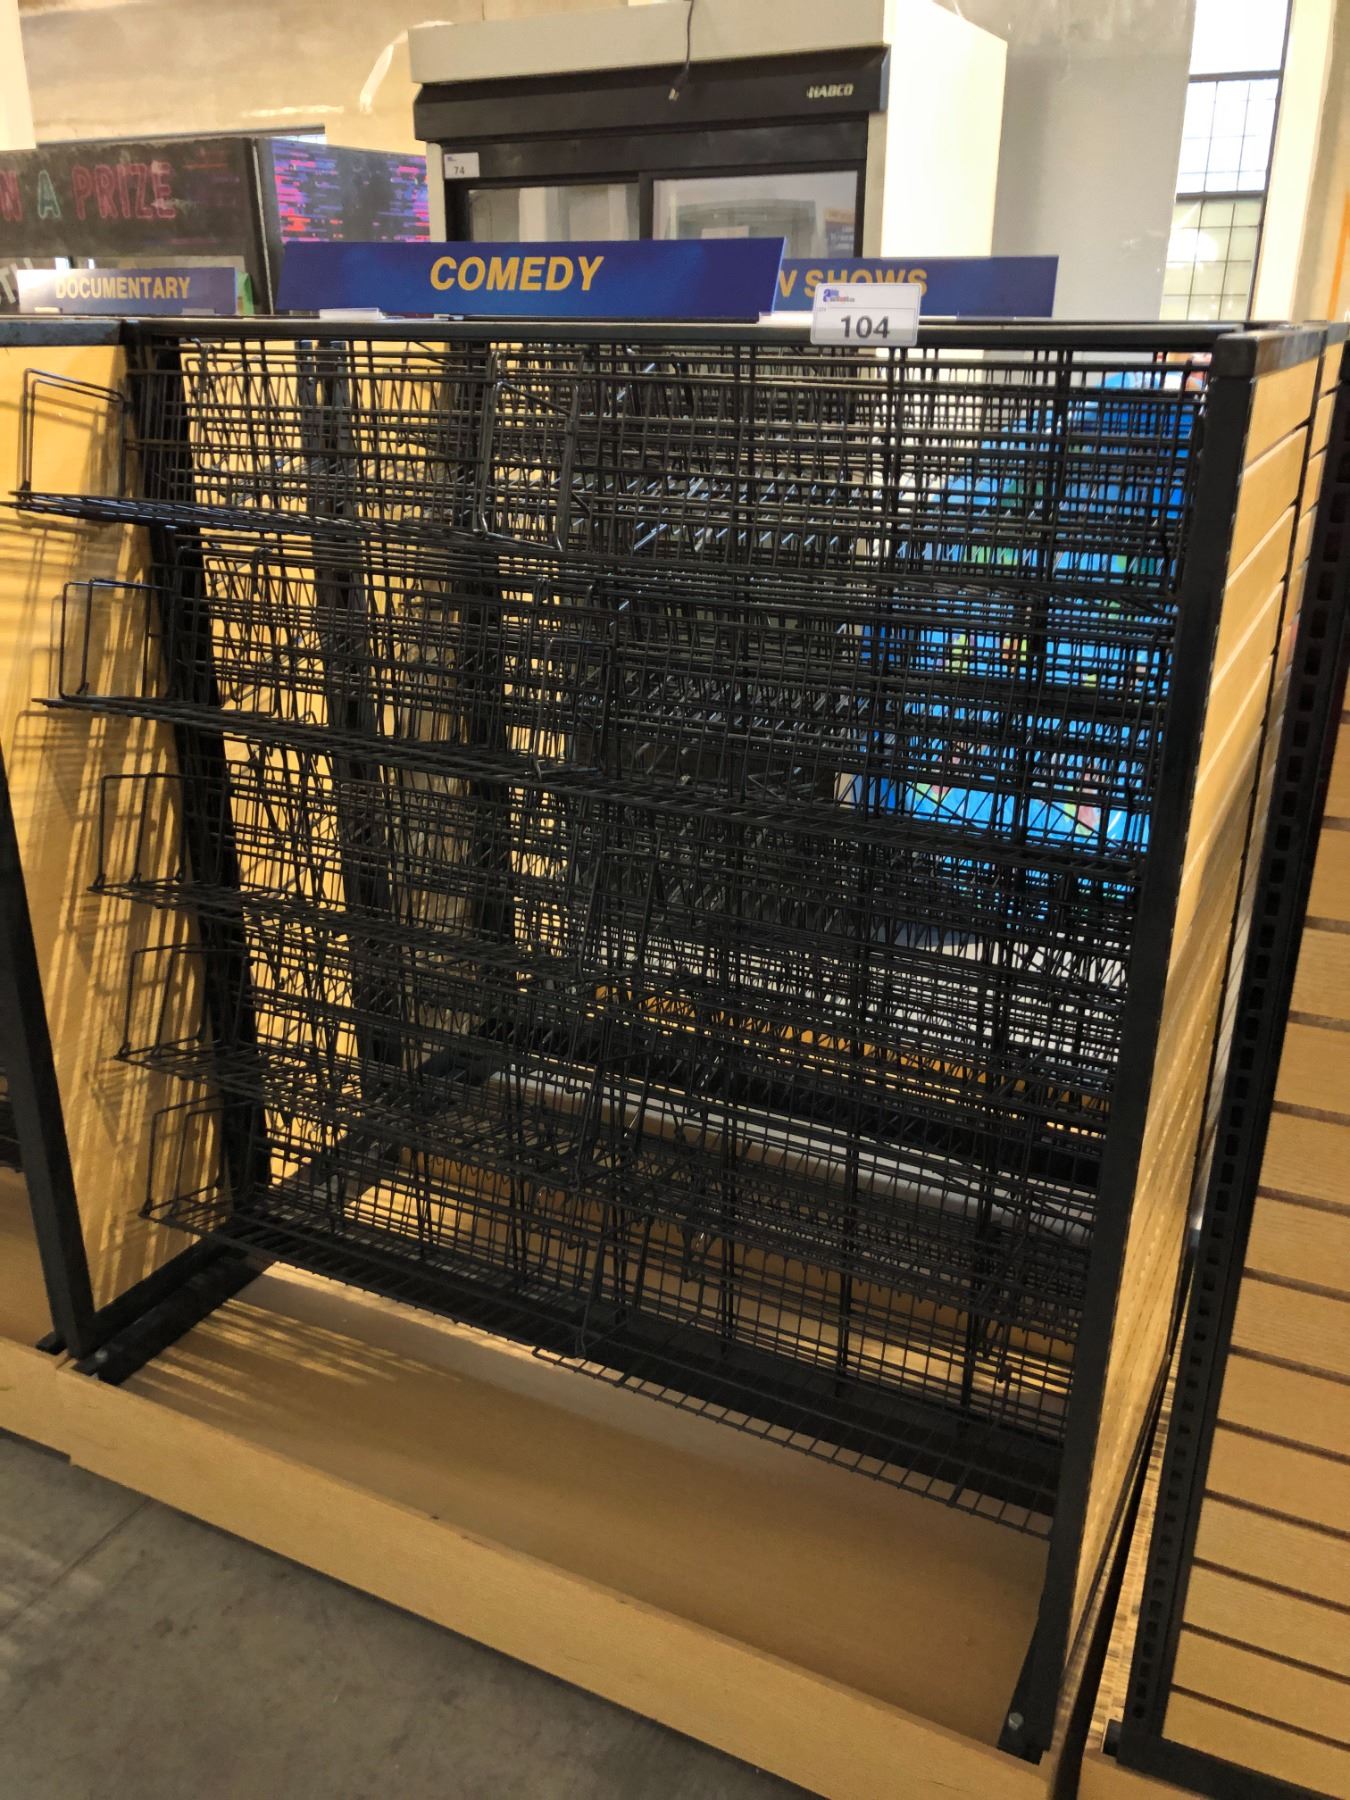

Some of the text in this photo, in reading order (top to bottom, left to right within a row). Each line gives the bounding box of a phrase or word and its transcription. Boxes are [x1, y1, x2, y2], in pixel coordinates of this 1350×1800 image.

[453, 165, 465, 176] 74
[38, 170, 61, 219] A
[71, 162, 177, 219] PRIZE
[430, 255, 605, 292] COMEDY
[55, 277, 190, 299] DOCUMENTARY
[841, 315, 890, 338] 104
